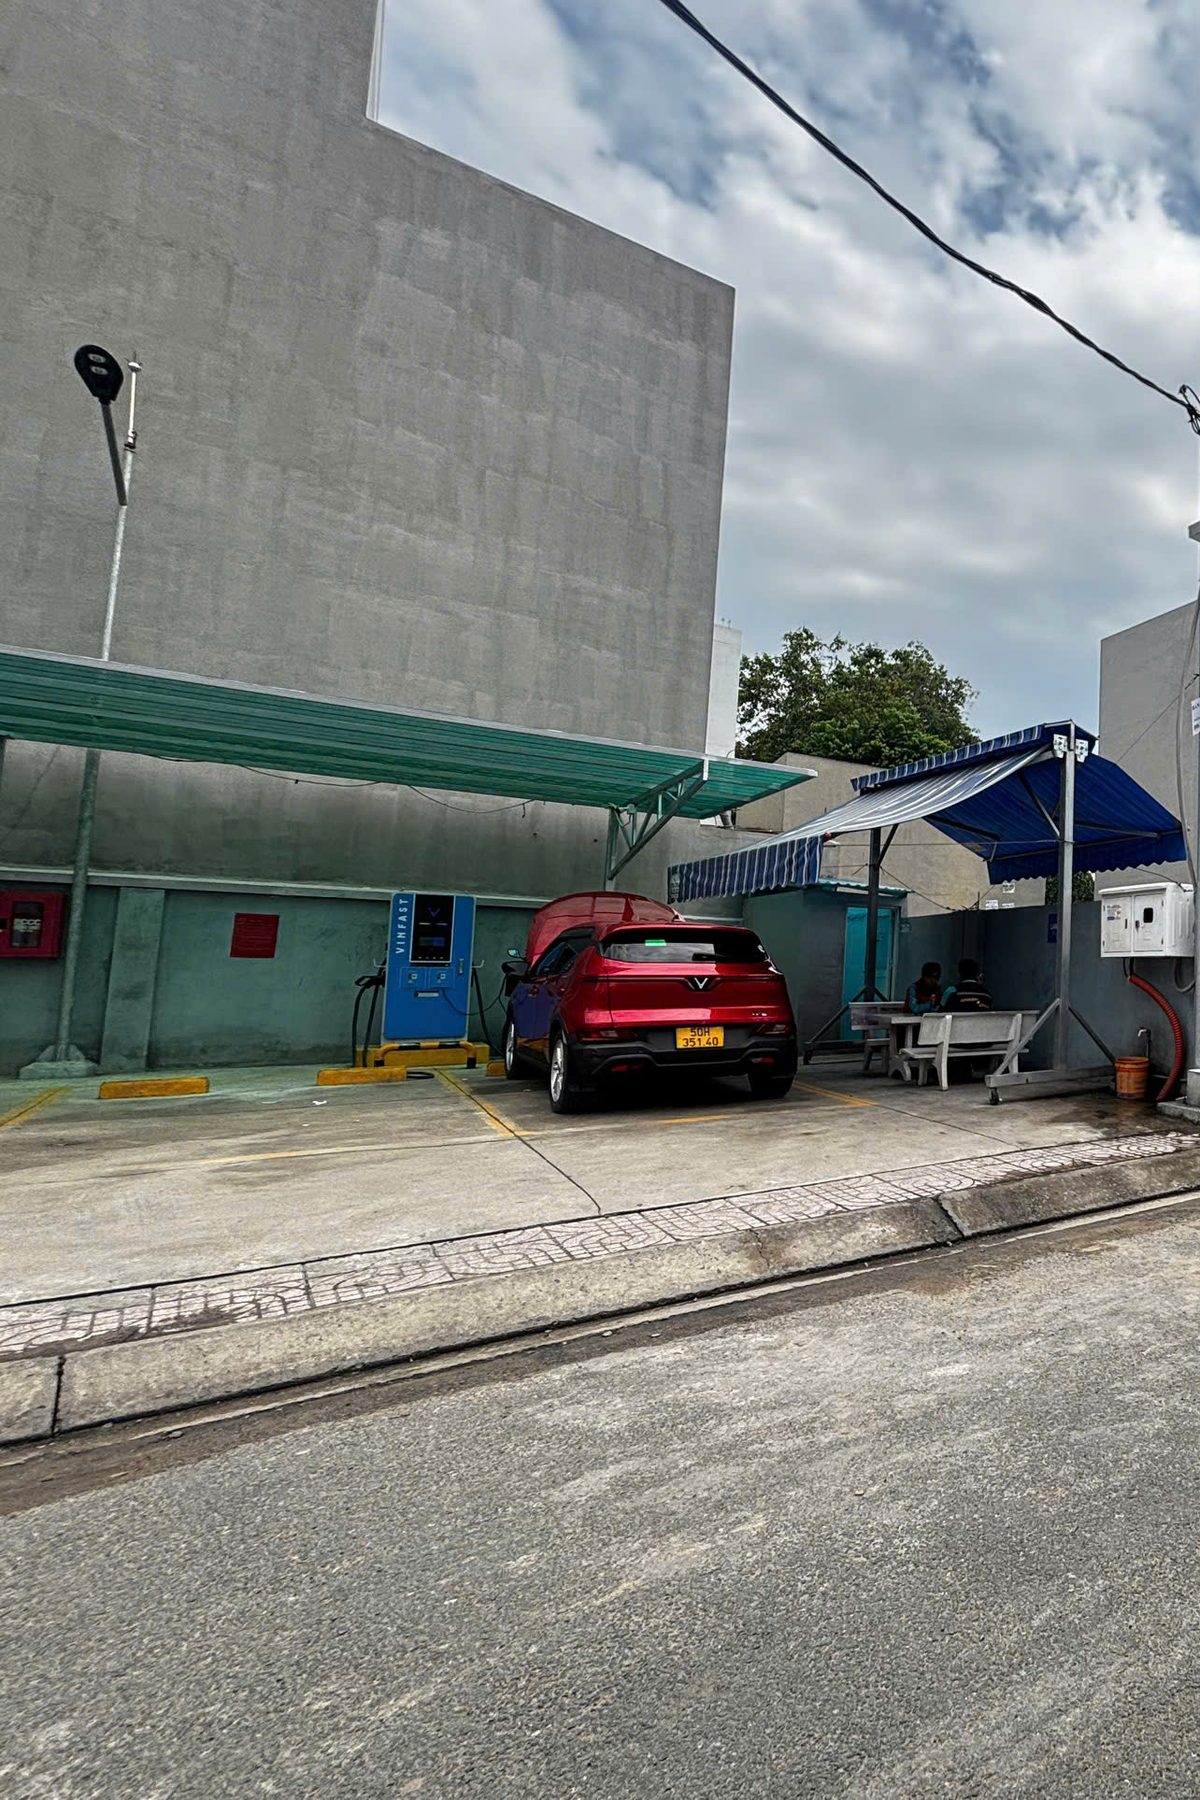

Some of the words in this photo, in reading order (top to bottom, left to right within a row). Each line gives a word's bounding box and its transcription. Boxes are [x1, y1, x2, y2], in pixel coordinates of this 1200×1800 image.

[395, 899, 409, 954] VINFAST
[690, 1027, 710, 1037] 50H
[682, 1036, 719, 1047] 351.40
